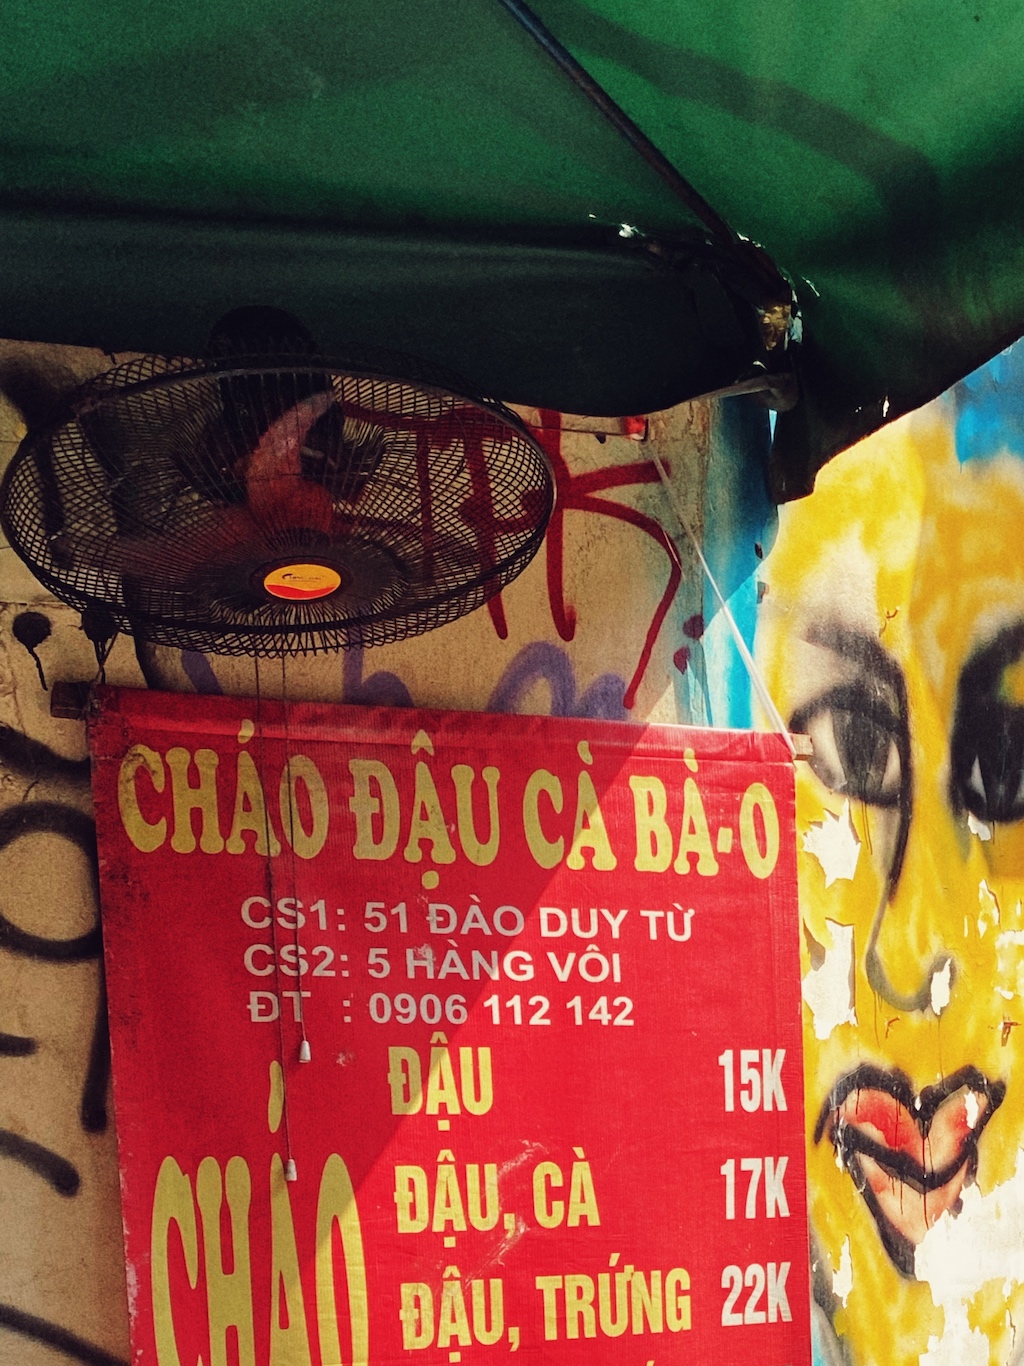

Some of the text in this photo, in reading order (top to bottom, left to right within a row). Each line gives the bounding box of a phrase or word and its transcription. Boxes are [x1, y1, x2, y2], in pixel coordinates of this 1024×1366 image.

[117, 718, 780, 890] CHÁO ĐẬU CÀ BÀ-O
[240, 894, 696, 942] CS1: 51 ĐÀO DUY TỪ
[243, 938, 623, 984] CS2: 5 HÀNG VÔI
[246, 990, 312, 1023] ĐT
[368, 992, 469, 1025] 0906
[482, 994, 552, 1026] 112
[565, 995, 635, 1027] 142
[387, 1031, 788, 1131] ĐẬU 15K
[393, 1146, 792, 1248] ĐẬU, CÀ 17K
[399, 1252, 794, 1363] ĐẬU, TRỨNG 22K
